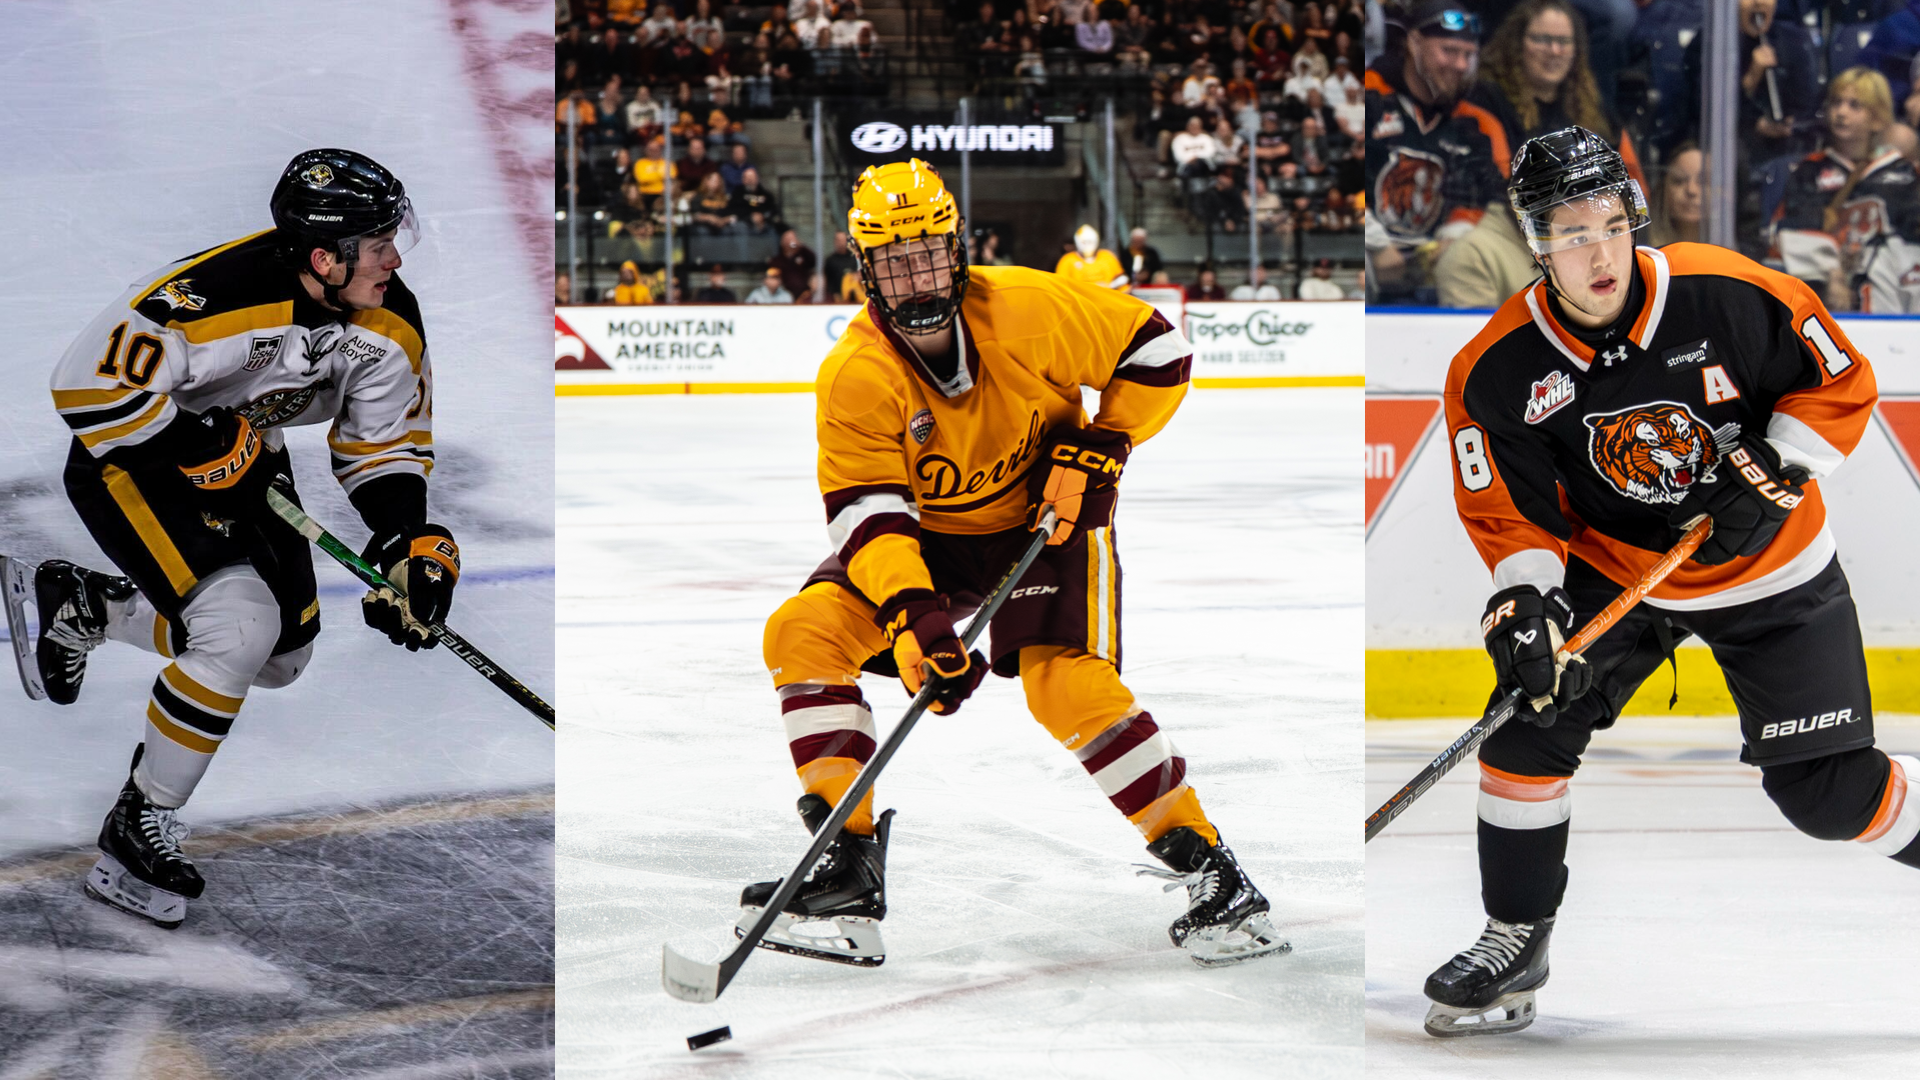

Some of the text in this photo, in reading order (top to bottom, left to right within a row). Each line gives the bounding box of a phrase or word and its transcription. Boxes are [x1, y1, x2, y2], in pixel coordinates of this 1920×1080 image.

[911, 124, 1054, 152] HYUNDAI
[896, 193, 908, 206] 11
[308, 213, 343, 222] BAUER
[890, 215, 925, 227] CCM
[608, 320, 734, 338] MOUNTAIN
[910, 314, 943, 326] CCM
[1246, 310, 1314, 346] Chico
[95, 321, 165, 390] 10
[348, 335, 388, 358] Aurora
[615, 341, 726, 359] AMERICA
[1667, 349, 1705, 367] stringam
[1800, 313, 1855, 379] 1
[1530, 379, 1573, 416] WHL
[1701, 364, 1740, 406] A
[1051, 444, 1123, 478] CCM
[1454, 424, 1494, 494] 8
[1010, 585, 1059, 599] CCM
[429, 624, 497, 678] BAUER
[1761, 708, 1853, 740] BAUER
[1432, 730, 1472, 768] BAUER
